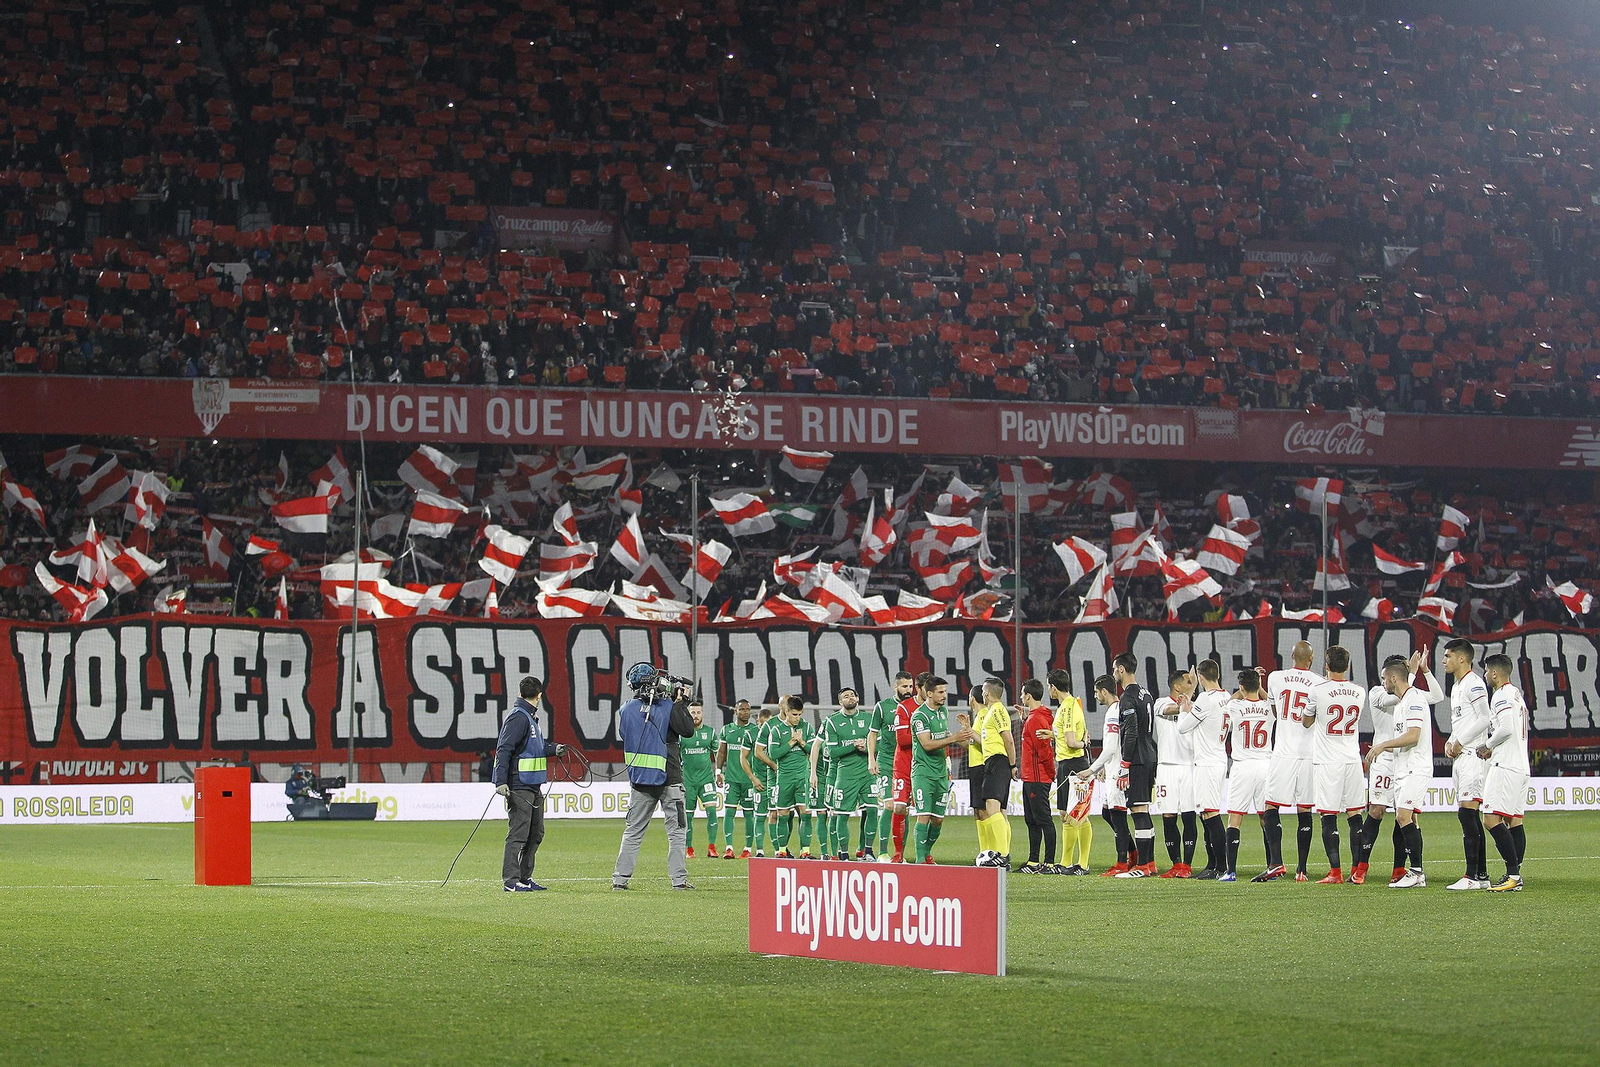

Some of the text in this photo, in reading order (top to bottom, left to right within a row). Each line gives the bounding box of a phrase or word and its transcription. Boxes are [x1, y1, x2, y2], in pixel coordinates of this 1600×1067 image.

[497, 214, 614, 236] Cruzcampo Radler
[346, 393, 919, 445] DICEN QUE NUNCA SE RINDE
[1001, 410, 1185, 449] PlayWSOP.com
[1283, 421, 1367, 455] Coca-Cola
[12, 622, 316, 749] VOLVER
[332, 624, 391, 748] A
[407, 623, 550, 748] SER
[1284, 676, 1313, 688] NZONZI
[1328, 689, 1360, 699] VAZQUEZ
[1240, 704, 1269, 717] J.NAVAS
[1280, 689, 1309, 723] 15
[1326, 704, 1360, 736] 22
[1238, 720, 1268, 749] 16
[1563, 754, 1583, 762] RUDE
[876, 776, 889, 788] 22
[893, 778, 905, 790] 13
[1375, 775, 1391, 789] 20
[753, 792, 761, 804] 10
[834, 789, 843, 801] 15
[916, 788, 923, 800] 8
[1543, 787, 1566, 805] LA
[1572, 786, 1600, 805] RO
[14, 795, 134, 817] ROSALEDA
[776, 867, 962, 951] PlayWSOP.com
